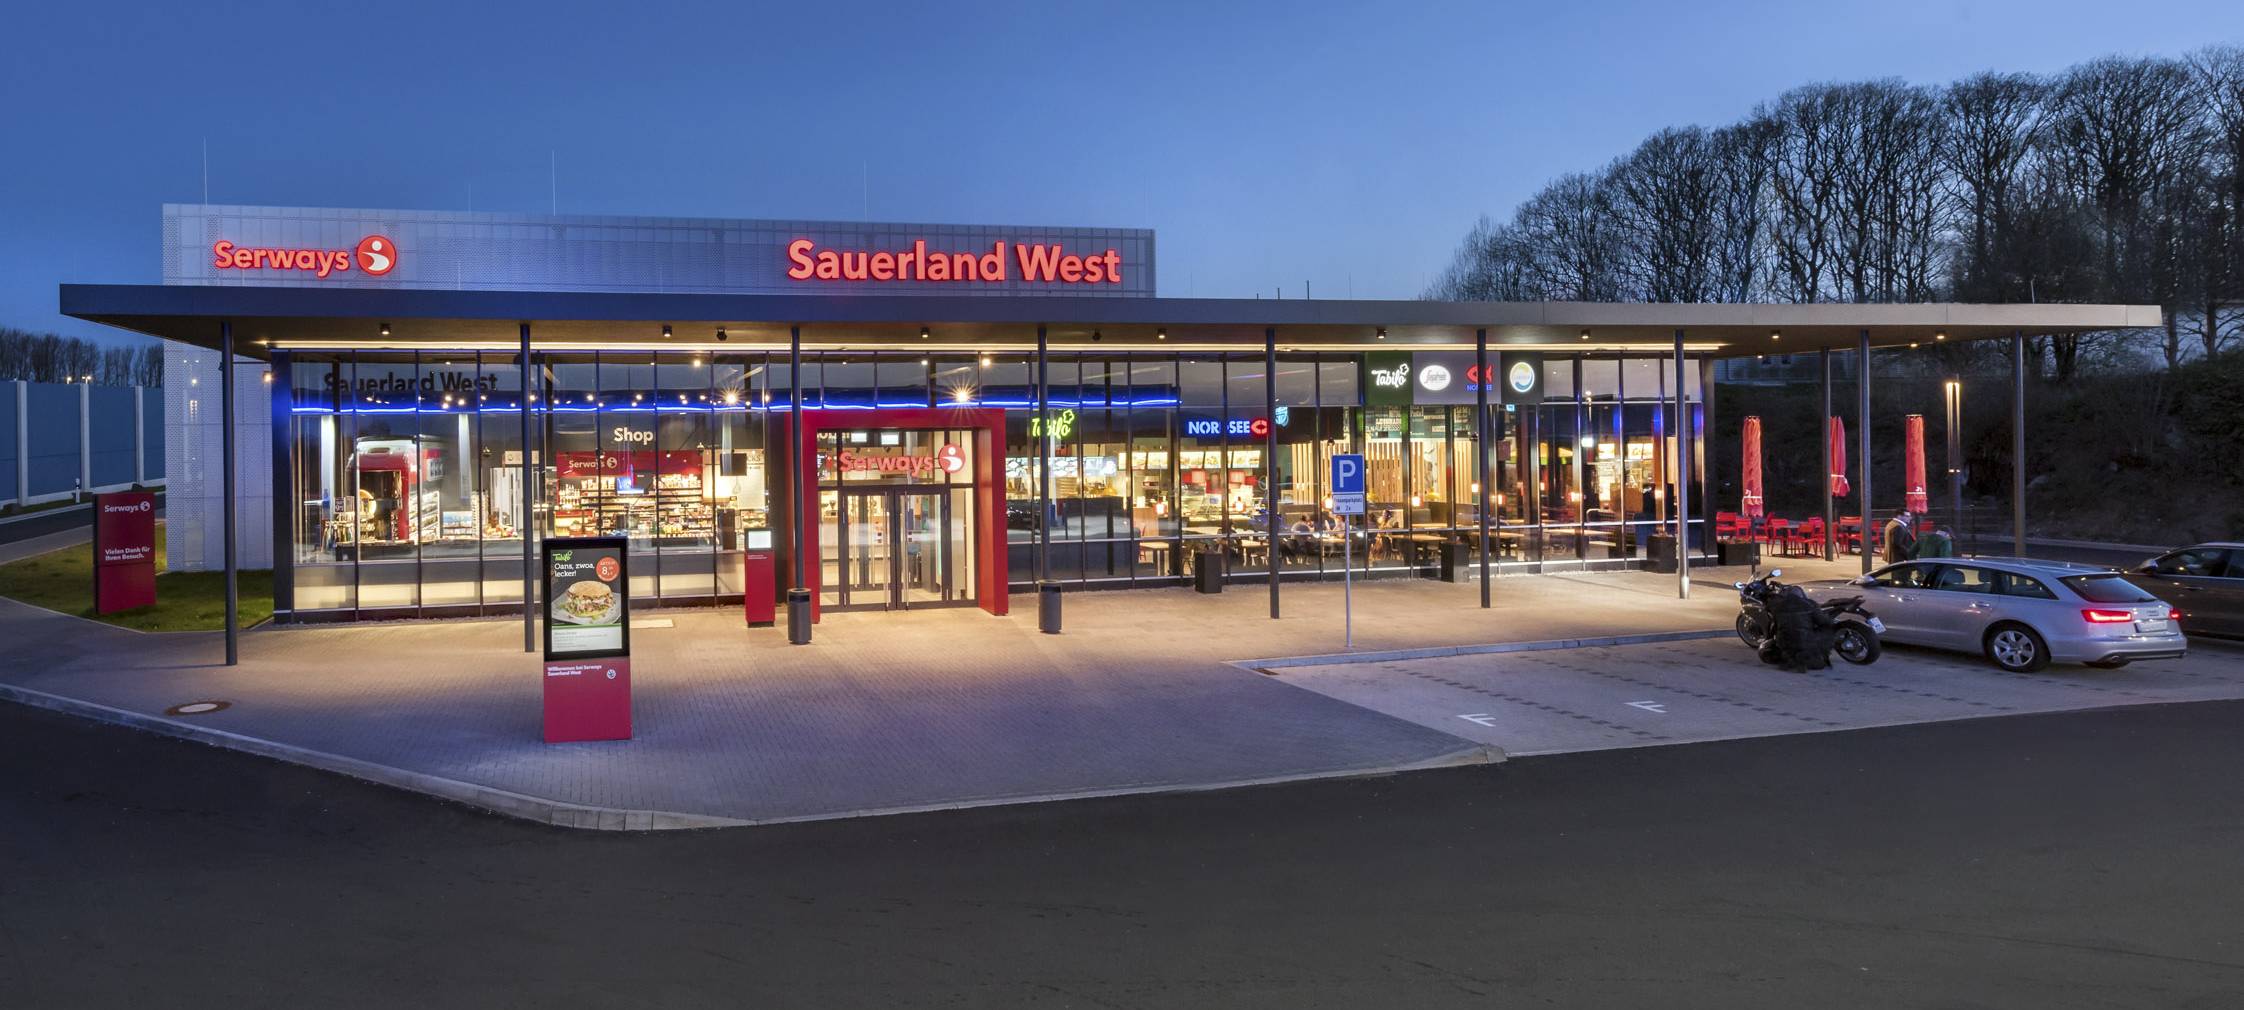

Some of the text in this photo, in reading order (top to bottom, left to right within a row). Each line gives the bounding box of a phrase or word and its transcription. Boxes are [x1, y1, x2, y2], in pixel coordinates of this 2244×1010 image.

[214, 240, 349, 278] Serways
[788, 240, 1120, 283] Sauerland West
[614, 427, 653, 445] Shop
[1188, 421, 1250, 434] NORSEE
[839, 451, 933, 477] Serways
[1339, 460, 1356, 488] P
[104, 504, 139, 513] Serways
